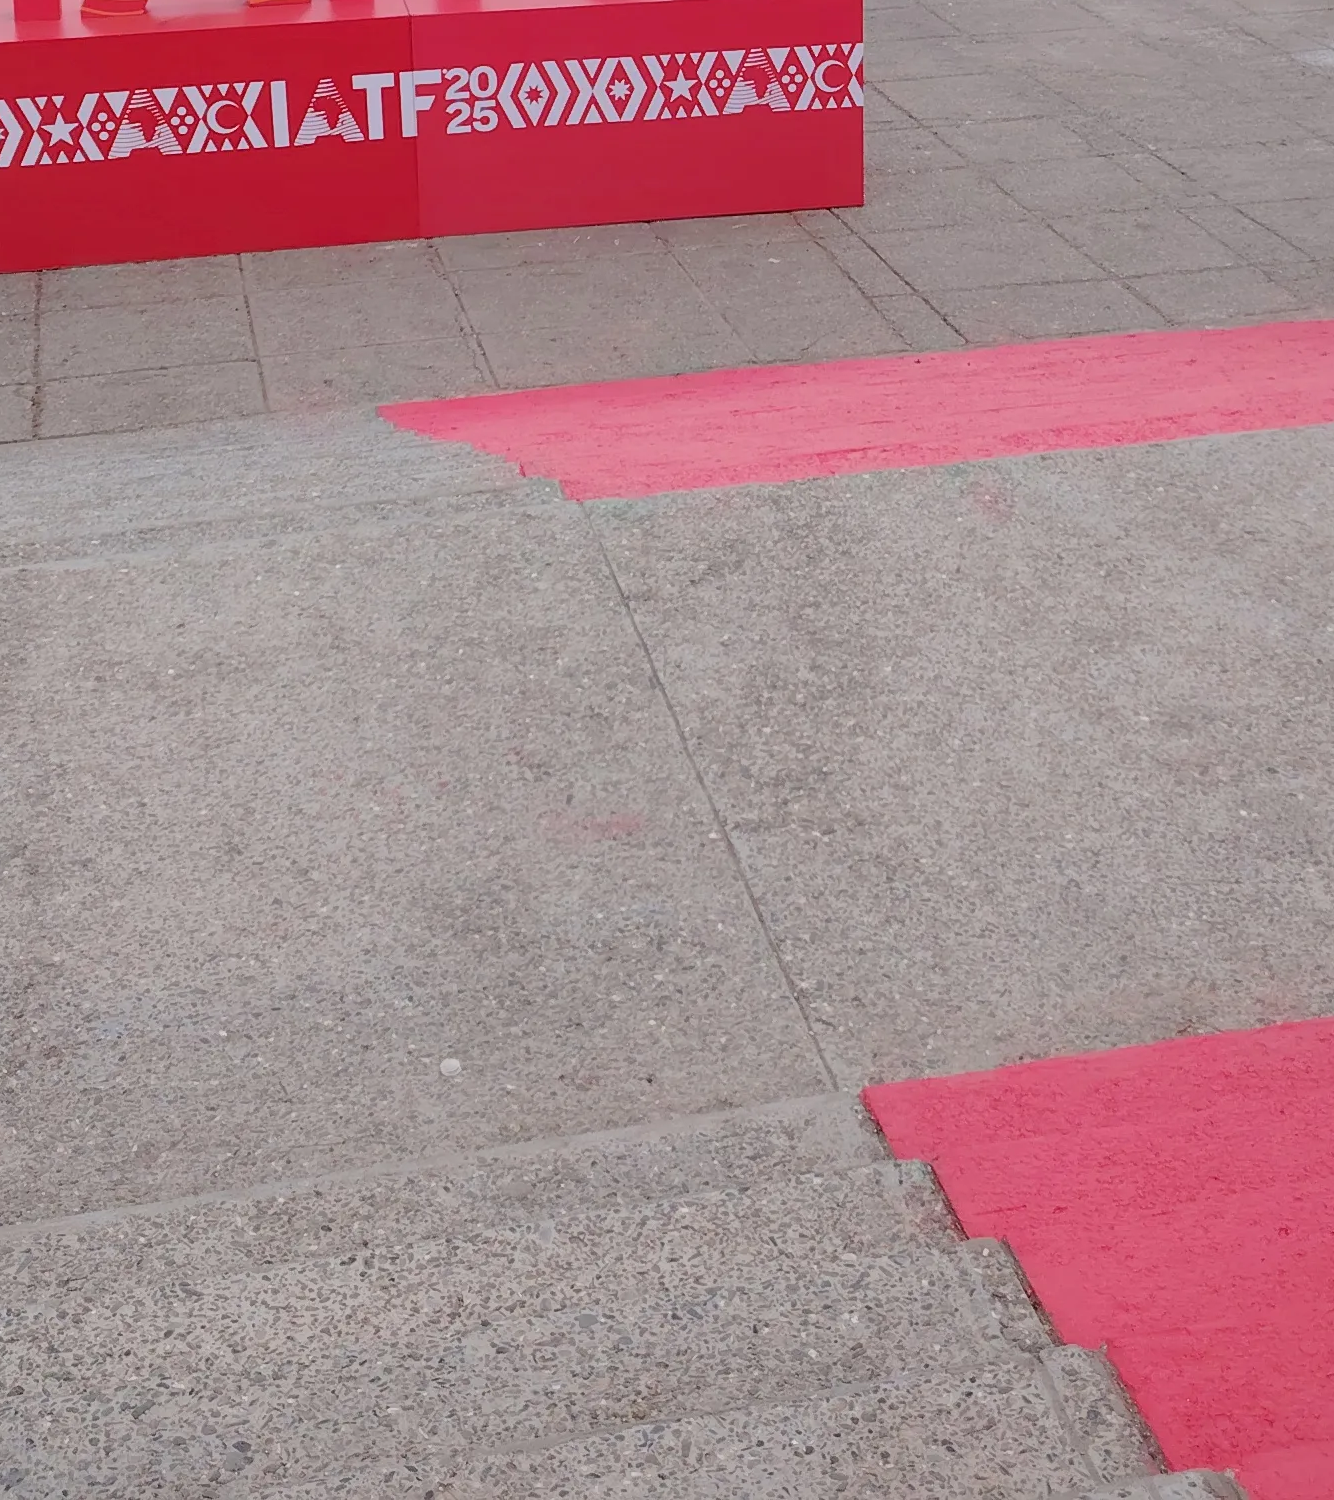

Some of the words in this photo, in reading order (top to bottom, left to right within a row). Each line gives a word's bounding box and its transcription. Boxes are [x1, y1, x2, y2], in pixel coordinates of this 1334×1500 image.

[446, 66, 498, 102] 20
[270, 69, 442, 148] IATF
[445, 102, 499, 135] 25
